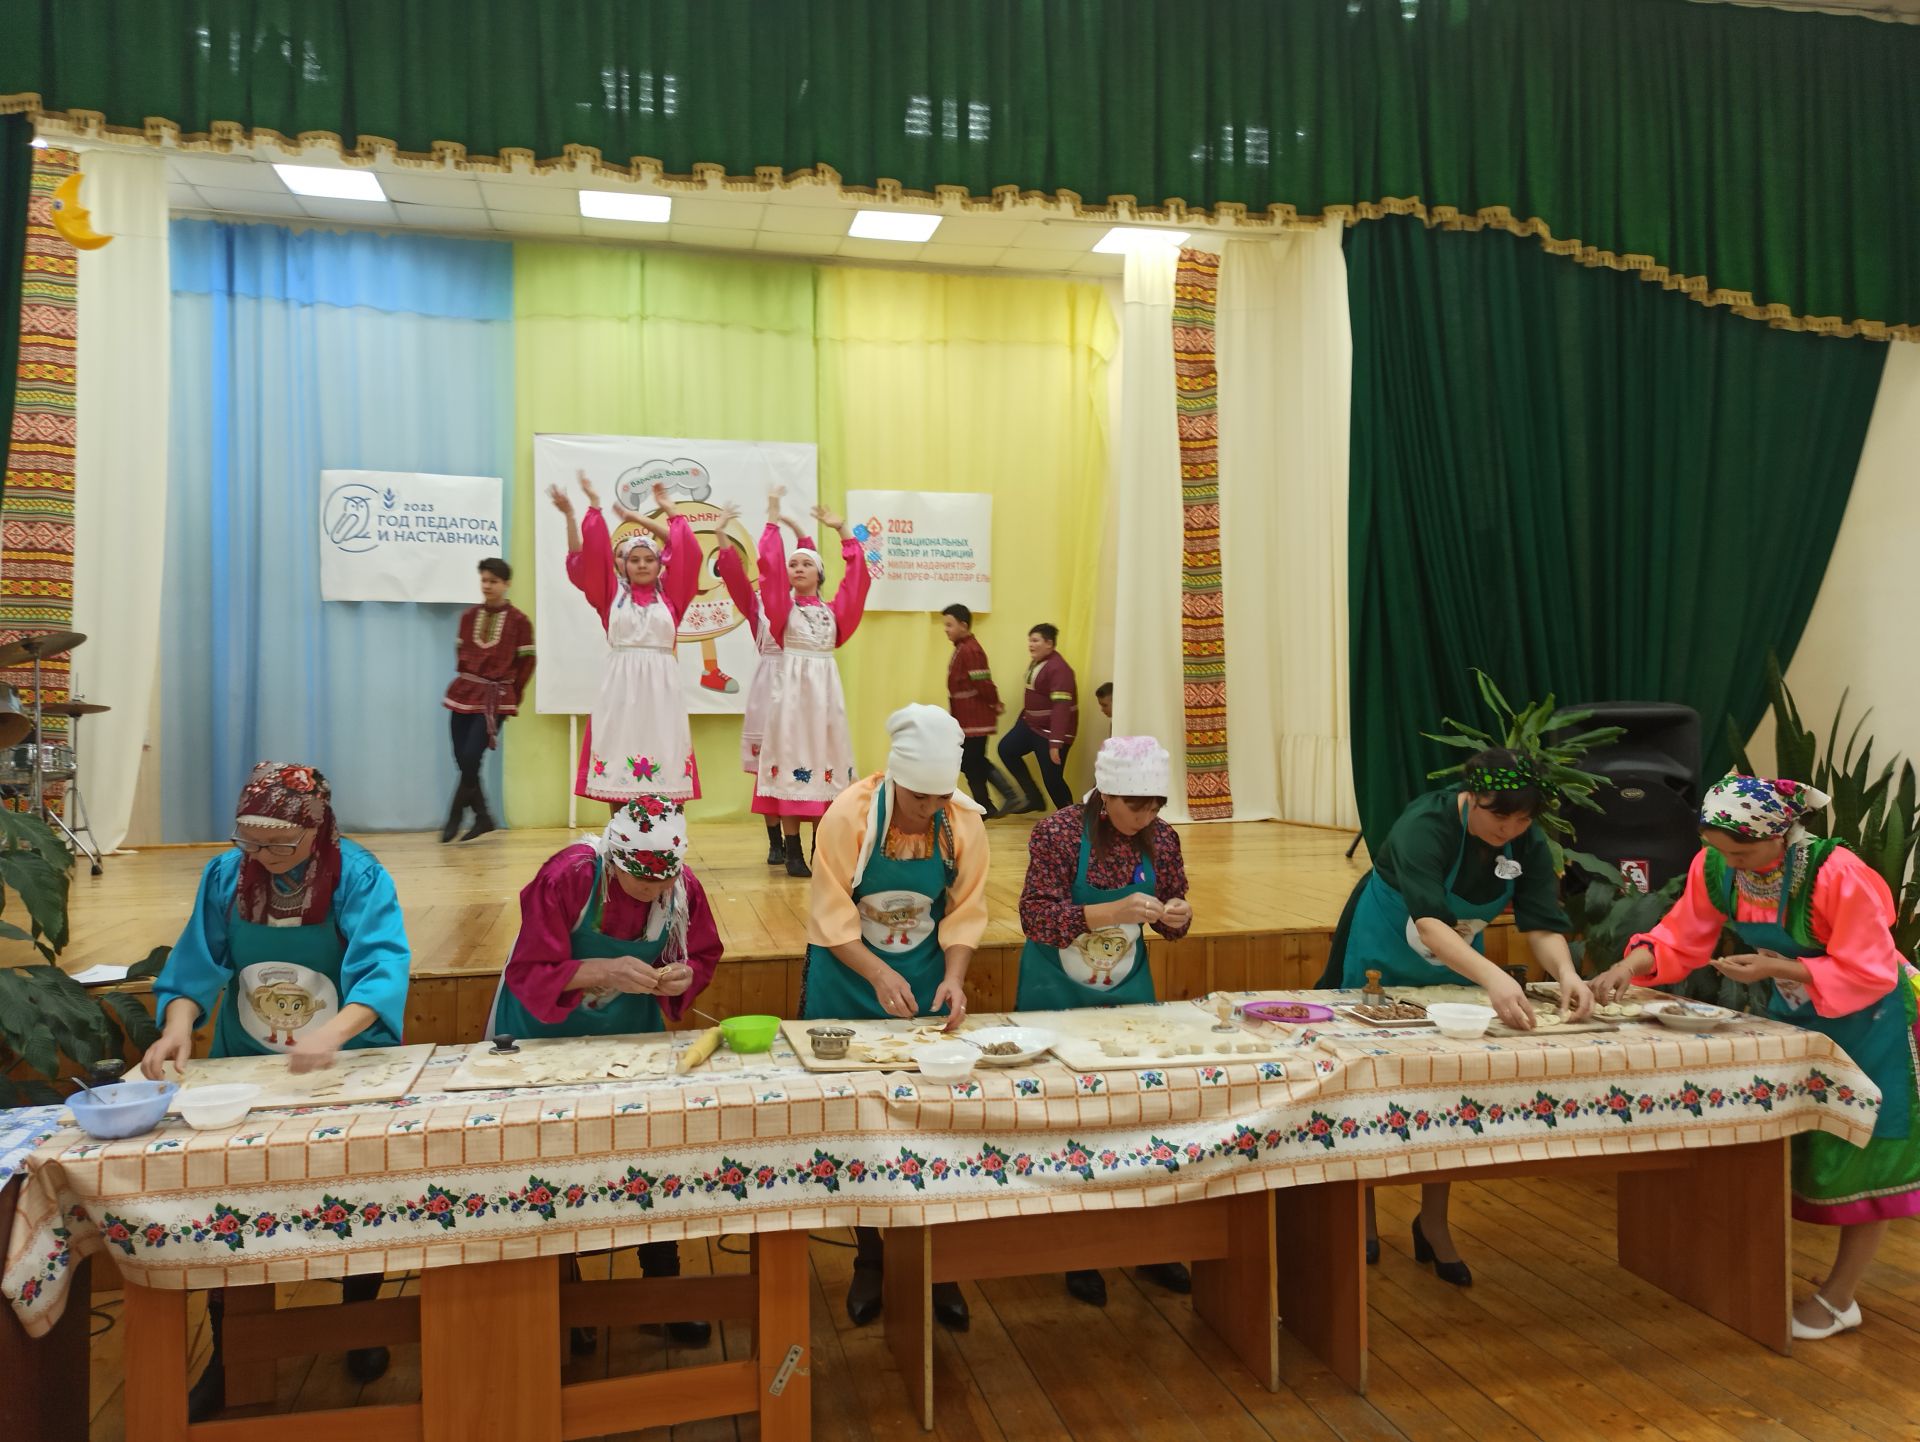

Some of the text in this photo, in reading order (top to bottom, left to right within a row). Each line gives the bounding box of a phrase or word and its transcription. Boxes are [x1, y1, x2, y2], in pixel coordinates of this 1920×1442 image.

[404, 503, 435, 512] 2023
[377, 515, 498, 531] ГОД ПЕДАГОГА
[888, 519, 913, 533] 2023
[377, 530, 499, 546] И НАСТАВНИКА
[888, 537, 968, 546] ГОД НАЦИОНАЛЬНЫХ
[888, 548, 974, 559] КУЛЬТУР И ТРАДИЦИЙ
